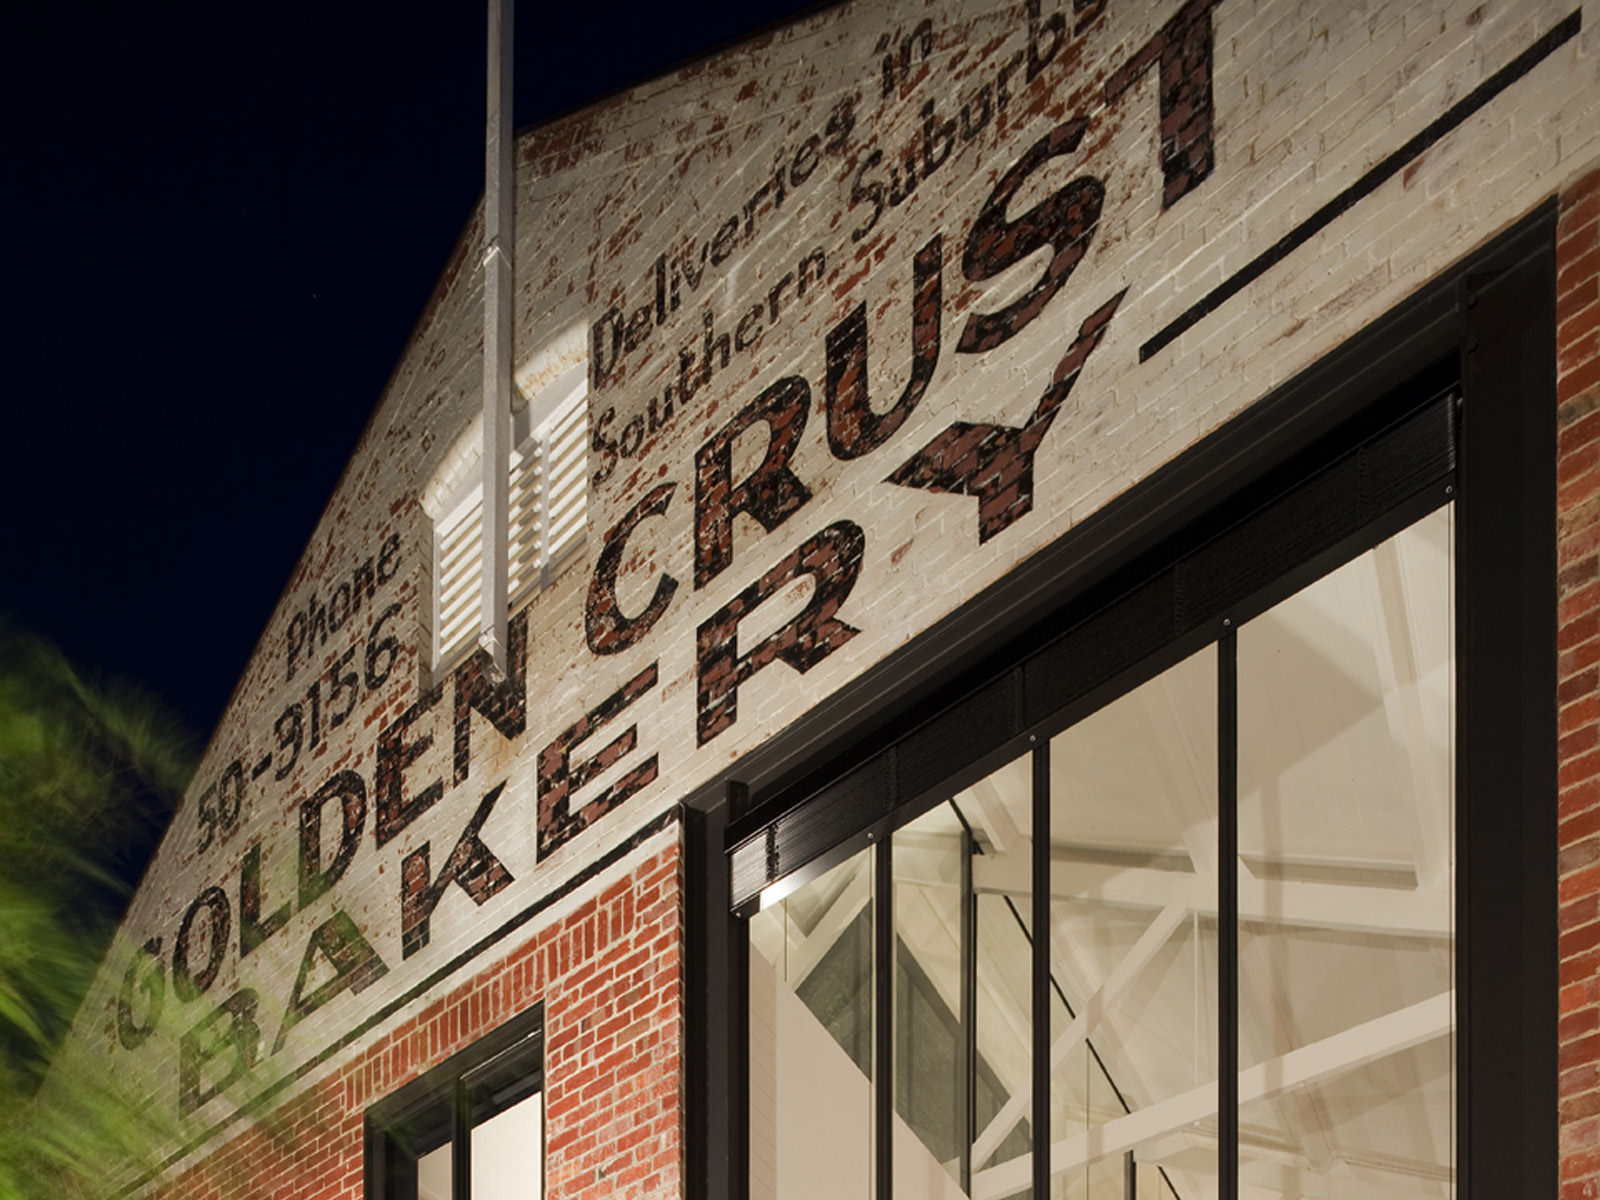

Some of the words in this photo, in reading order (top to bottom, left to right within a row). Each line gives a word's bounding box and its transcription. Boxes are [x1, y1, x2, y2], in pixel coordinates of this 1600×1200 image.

[591, 96, 857, 389] Deliveries
[880, 18, 933, 98] in
[591, 244, 827, 484] Southern
[117, 606, 528, 1051] GOLDEN
[585, 0, 1223, 656] CRUST
[178, 285, 1131, 1121] BAKERY
[198, 602, 402, 855] 50-9156
